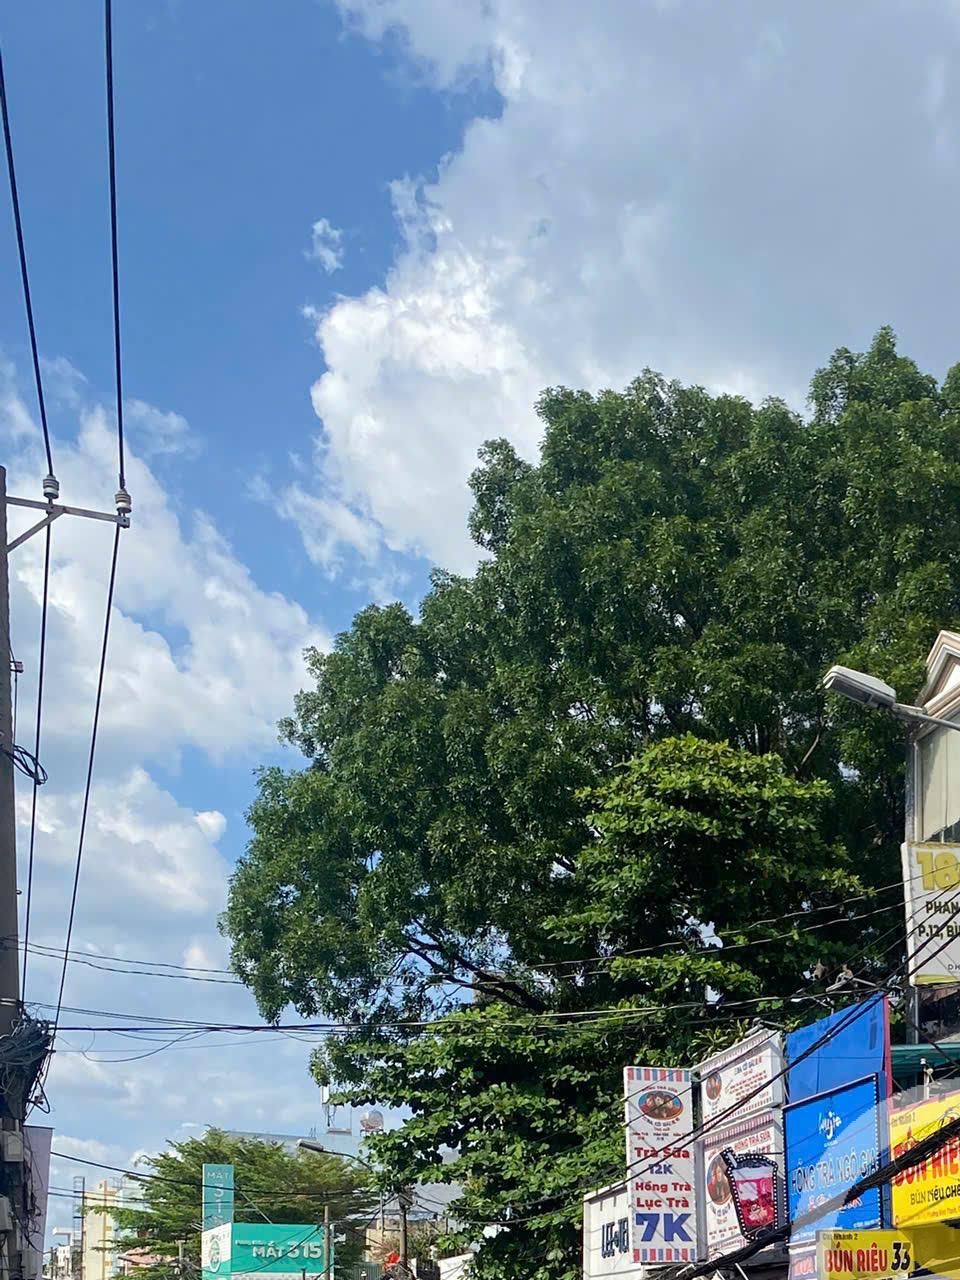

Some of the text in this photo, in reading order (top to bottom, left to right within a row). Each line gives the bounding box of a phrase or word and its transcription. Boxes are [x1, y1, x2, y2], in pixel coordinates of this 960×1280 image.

[925, 901, 959, 915] PHAN
[634, 1146, 658, 1158] Trà
[817, 1154, 834, 1187] TRÀ
[839, 1147, 857, 1183] NGÔ
[635, 1181, 691, 1193] Hồng Trà
[636, 1197, 689, 1210] Lục Trà
[635, 1213, 693, 1242] 7K
[287, 1242, 322, 1259] 315
[823, 1241, 911, 1272] BÚN RIÊU 33
